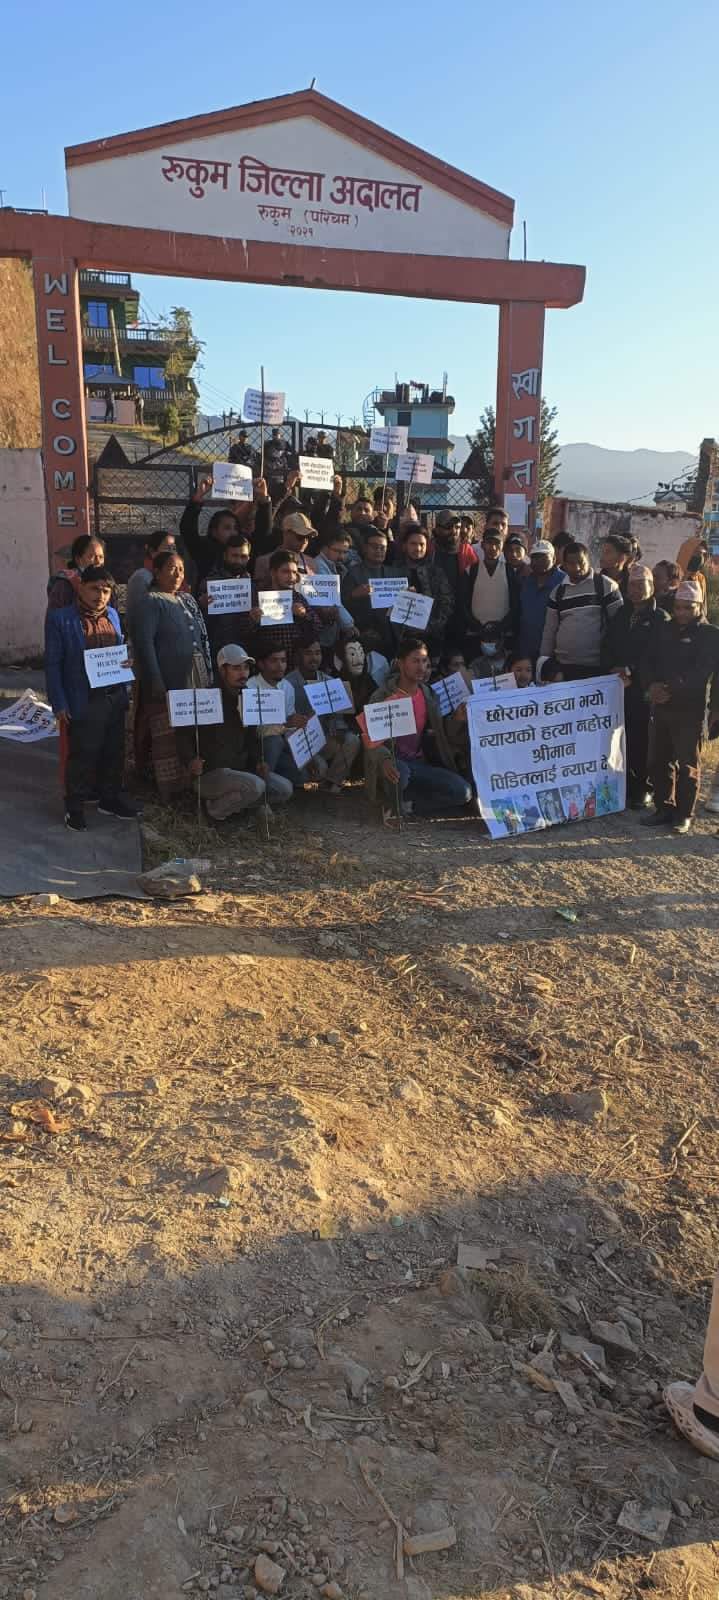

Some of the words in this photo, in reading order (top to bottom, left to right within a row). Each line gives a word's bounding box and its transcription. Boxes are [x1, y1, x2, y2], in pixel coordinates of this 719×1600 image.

[238, 155, 326, 202] जिल्ला
[330, 175, 423, 213] अदालत
[486, 700, 539, 723] छोराको
[543, 697, 575, 715] हत्या
[479, 725, 536, 748] न्यायको
[541, 722, 573, 741] हत्या
[561, 759, 597, 777] न्याय
